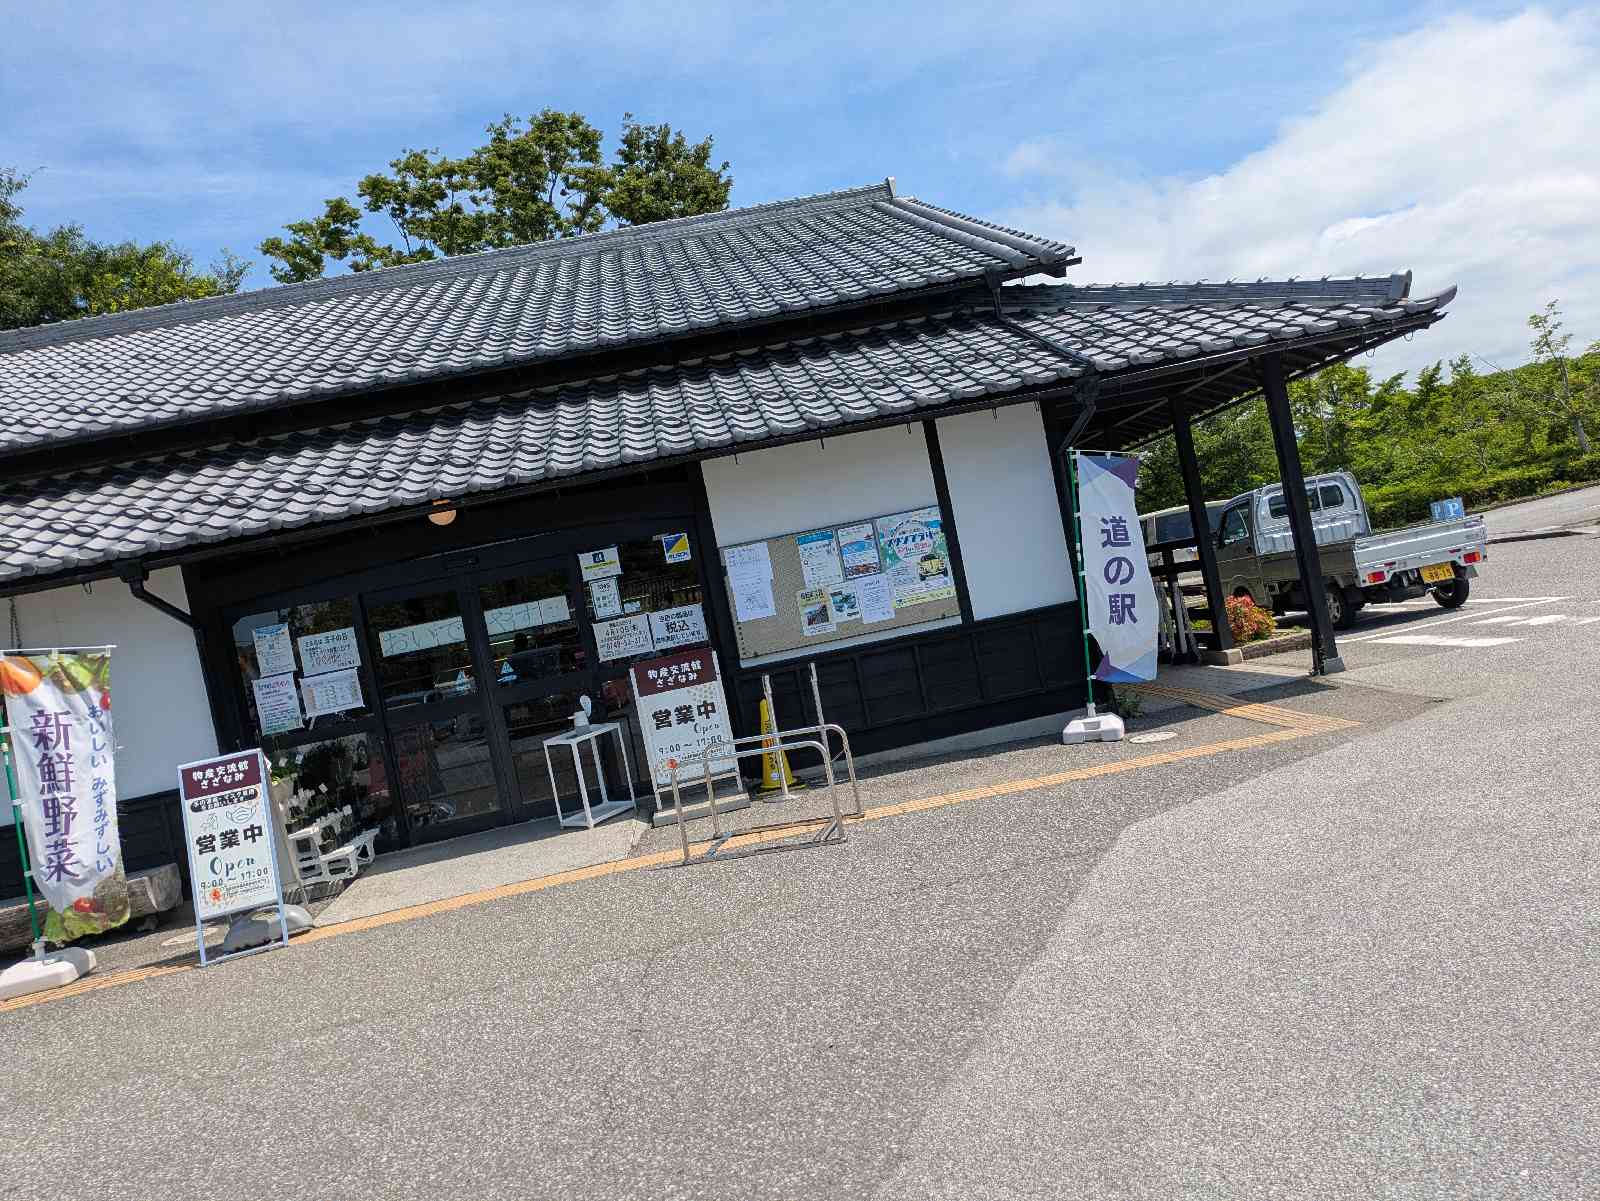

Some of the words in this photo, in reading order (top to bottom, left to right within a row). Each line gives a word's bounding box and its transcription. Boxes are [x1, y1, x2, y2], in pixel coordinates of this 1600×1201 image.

[1100, 515, 1138, 626] 道の駅
[648, 659, 702, 681] 物産交流館
[656, 673, 697, 688] さざなみ
[652, 700, 717, 731] 営業中
[88, 704, 108, 768] おいしい
[693, 722, 720, 736] Open
[659, 743, 681, 755] 9:00
[696, 735, 722, 748] 17:00
[192, 760, 249, 781] 物産交流館
[200, 772, 245, 789] さざなみ
[30, 710, 80, 882] 新鮮野菜
[91, 776, 114, 873] みずみずしい
[195, 824, 263, 855] 営業中
[200, 878, 223, 889] 9:00
[240, 867, 268, 880] 17:00
[209, 856, 255, 878] Open
